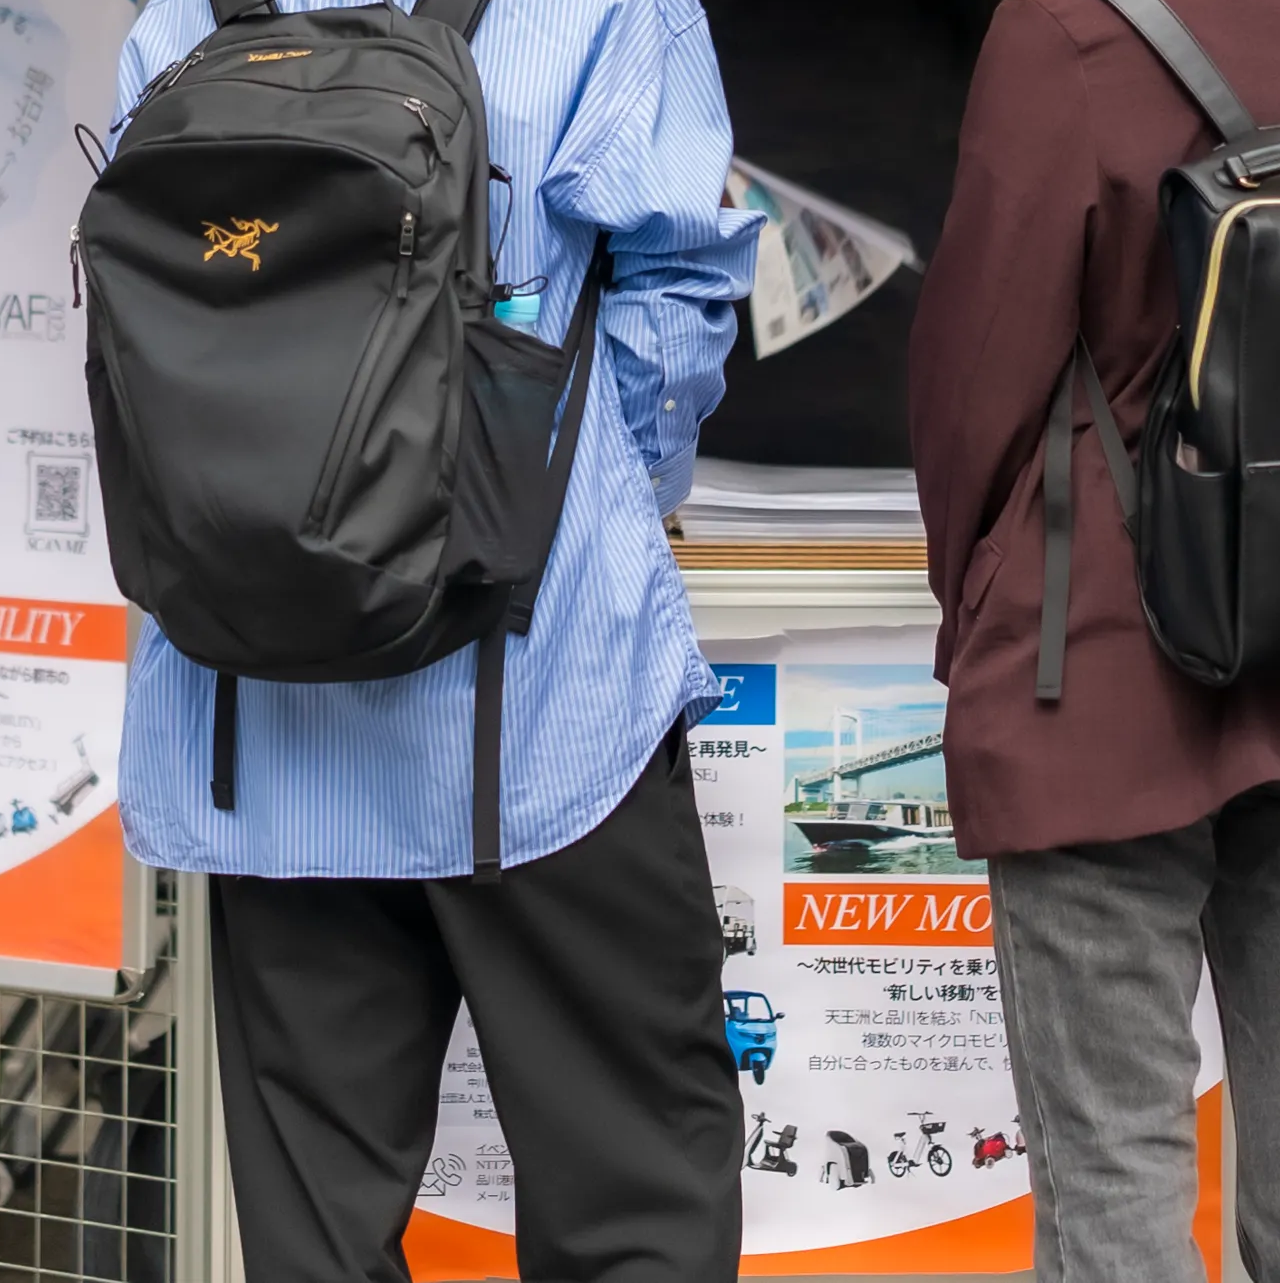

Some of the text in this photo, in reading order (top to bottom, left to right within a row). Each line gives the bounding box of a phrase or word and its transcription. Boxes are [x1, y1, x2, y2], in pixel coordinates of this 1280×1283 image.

[7, 428, 94, 448] ご予約はこちら
[795, 893, 915, 931] NEW
[476, 1160, 513, 1170] NTTア
